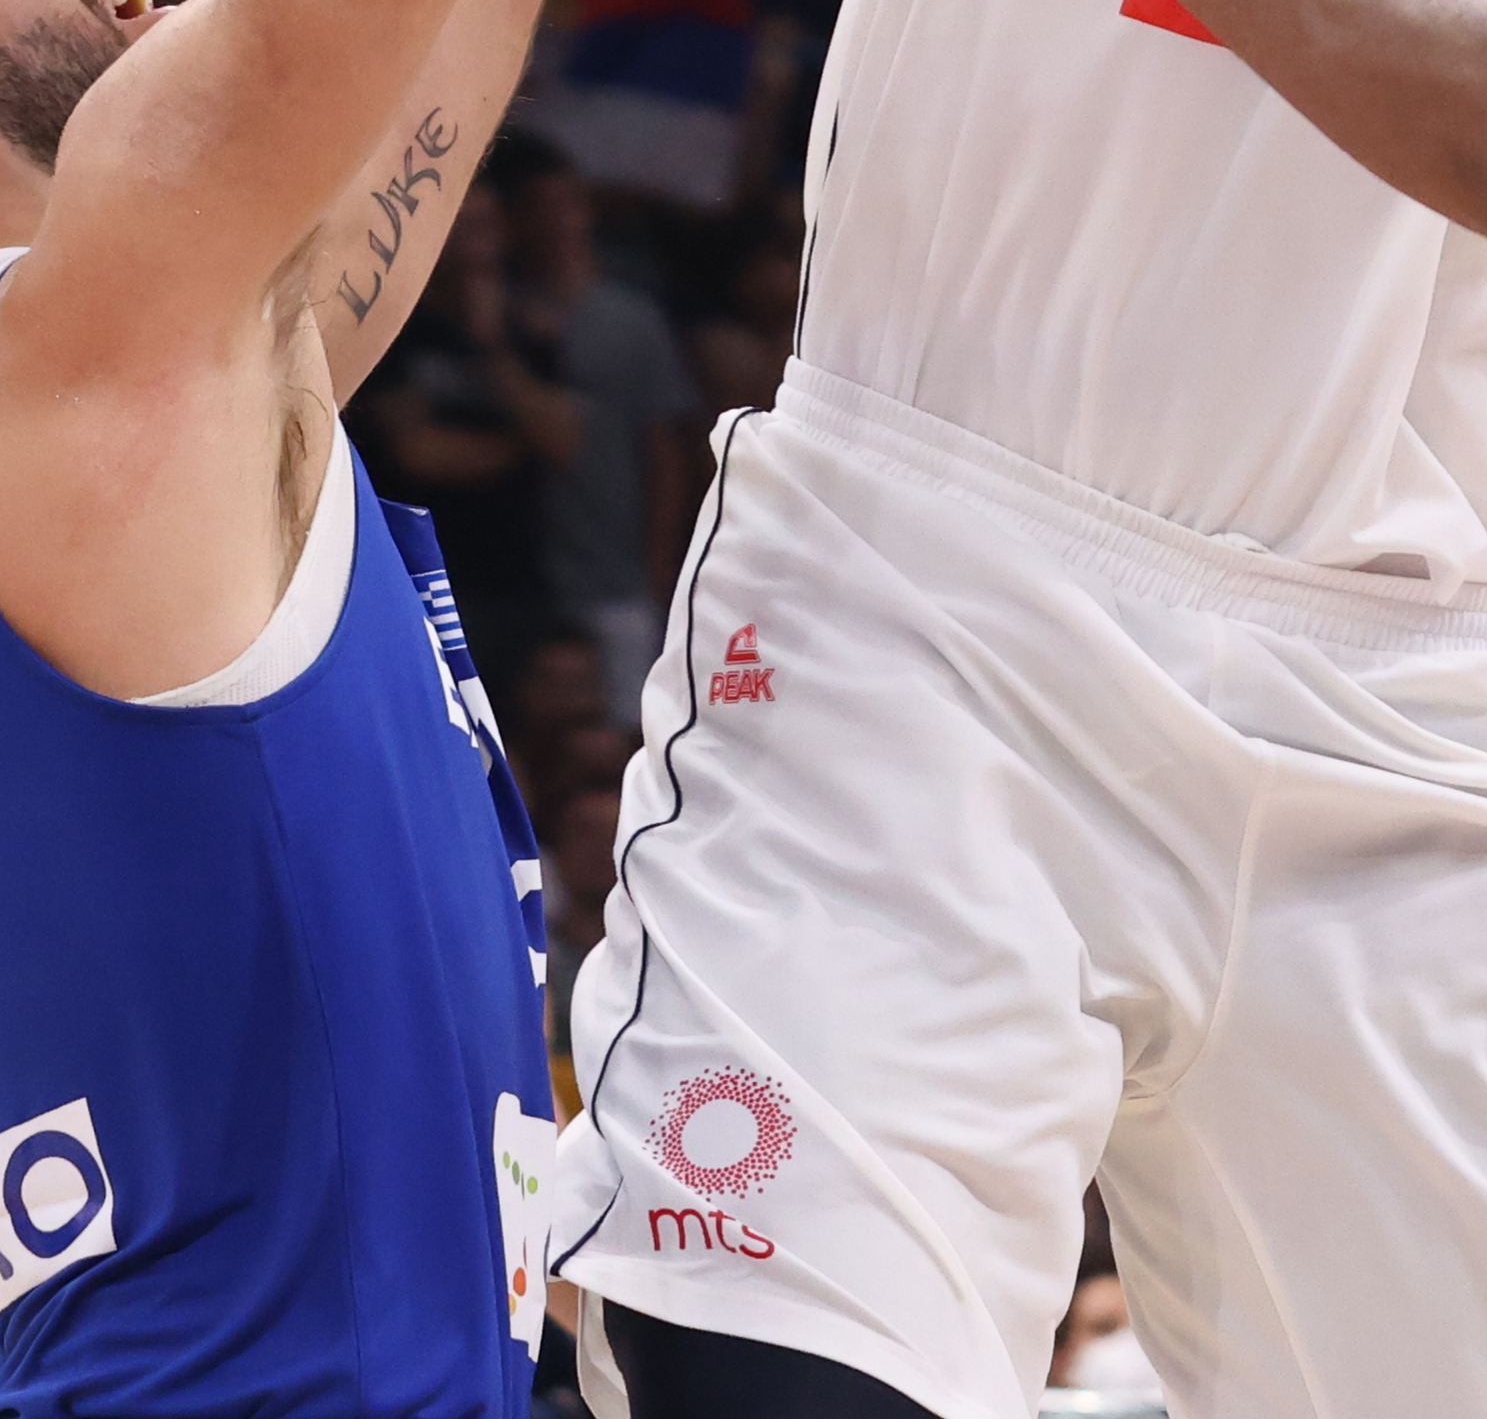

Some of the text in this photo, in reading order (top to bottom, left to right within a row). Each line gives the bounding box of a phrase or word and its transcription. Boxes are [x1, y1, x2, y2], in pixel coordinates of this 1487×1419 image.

[336, 106, 459, 328] LUKE
[709, 668, 776, 706] PEAK
[648, 1208, 775, 1259] mts
